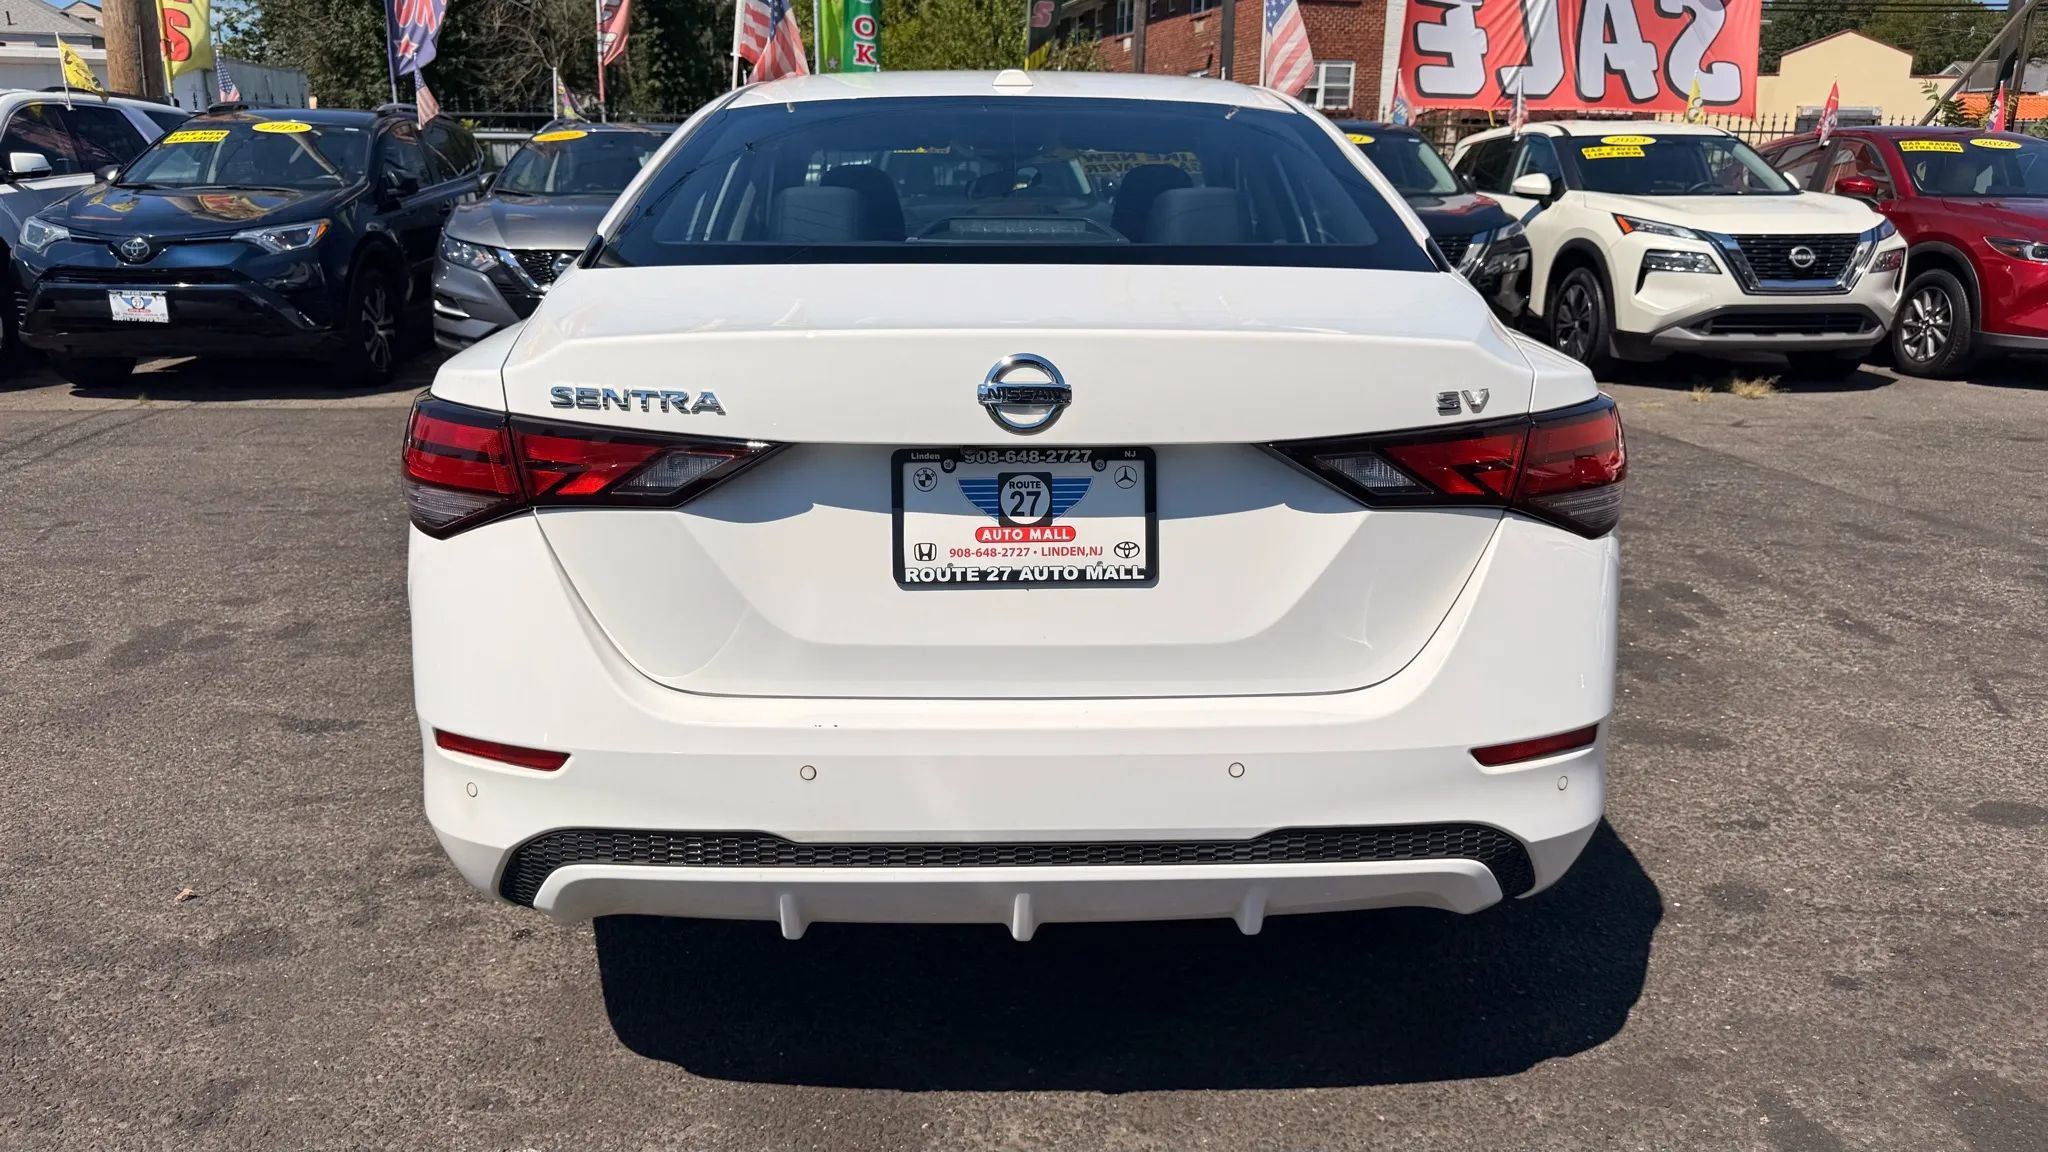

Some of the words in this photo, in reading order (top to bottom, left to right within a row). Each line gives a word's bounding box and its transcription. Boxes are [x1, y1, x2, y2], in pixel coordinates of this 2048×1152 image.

[550, 386, 726, 416] SENTRA
[987, 386, 1061, 401] NISSAN
[1437, 388, 1490, 416] SV
[910, 452, 940, 460] Linden
[964, 449, 1092, 464] 908-648-2727
[1124, 450, 1137, 458] NJ
[1008, 480, 1041, 489] ROUTE
[1010, 491, 1042, 517] 27
[981, 529, 1022, 541] AUTO
[1029, 528, 1070, 540] MALL
[949, 547, 1030, 558] 908-648-2727
[1041, 546, 1103, 558] LINDEN,NJ
[905, 567, 980, 582] ROUTE
[986, 566, 1012, 582] 27
[1018, 566, 1079, 581] AUTO
[1086, 565, 1145, 580] MALL
